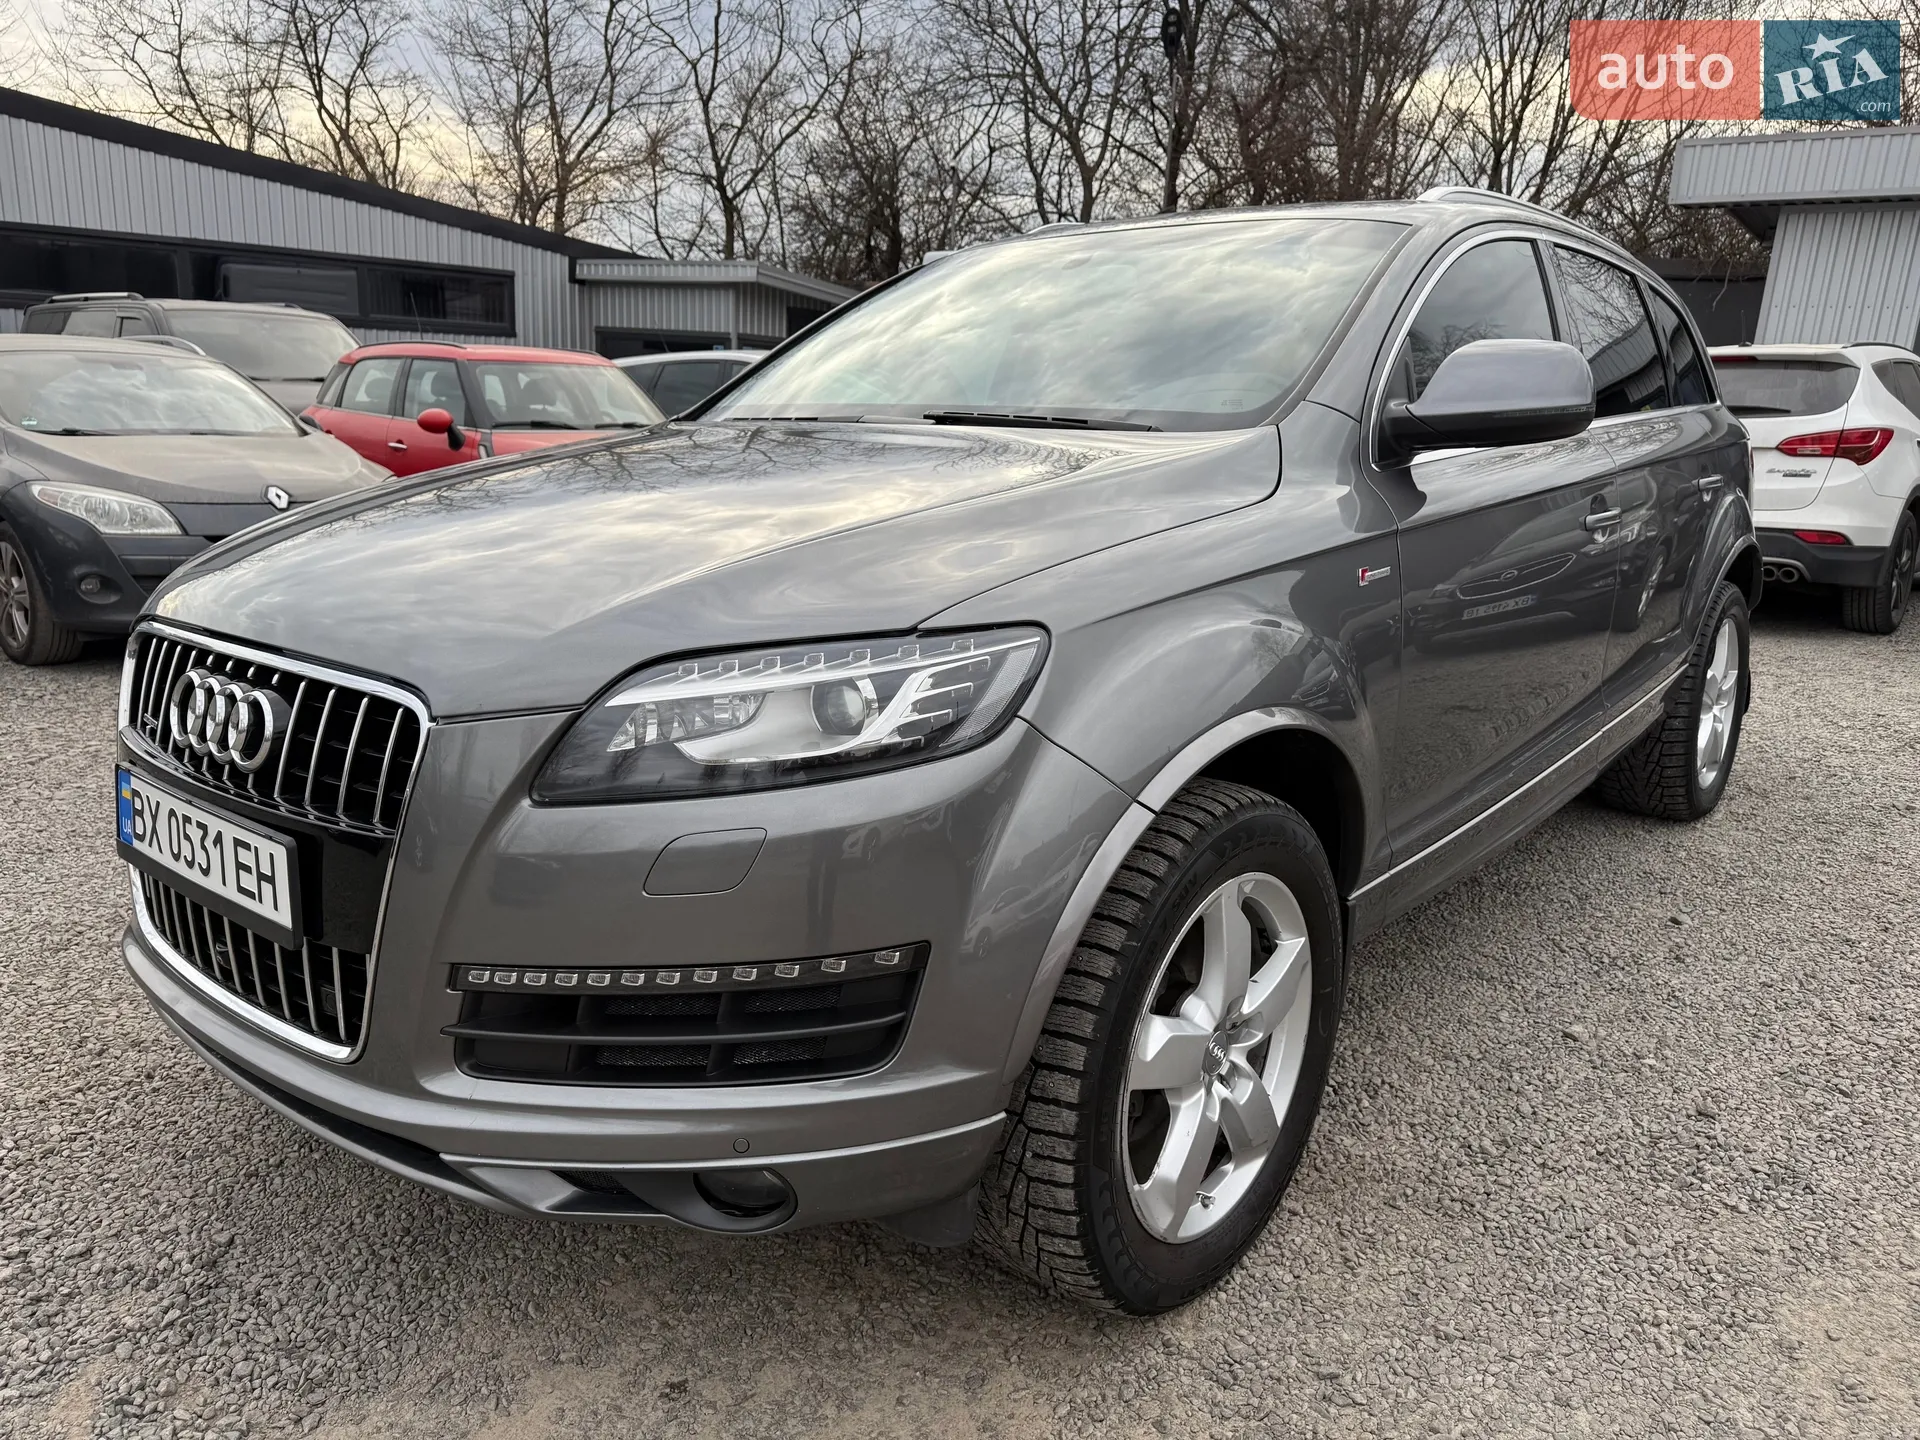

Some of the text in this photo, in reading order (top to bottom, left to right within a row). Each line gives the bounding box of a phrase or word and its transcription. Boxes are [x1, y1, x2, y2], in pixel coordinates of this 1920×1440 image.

[132, 787, 279, 912] BX 0531 EH
